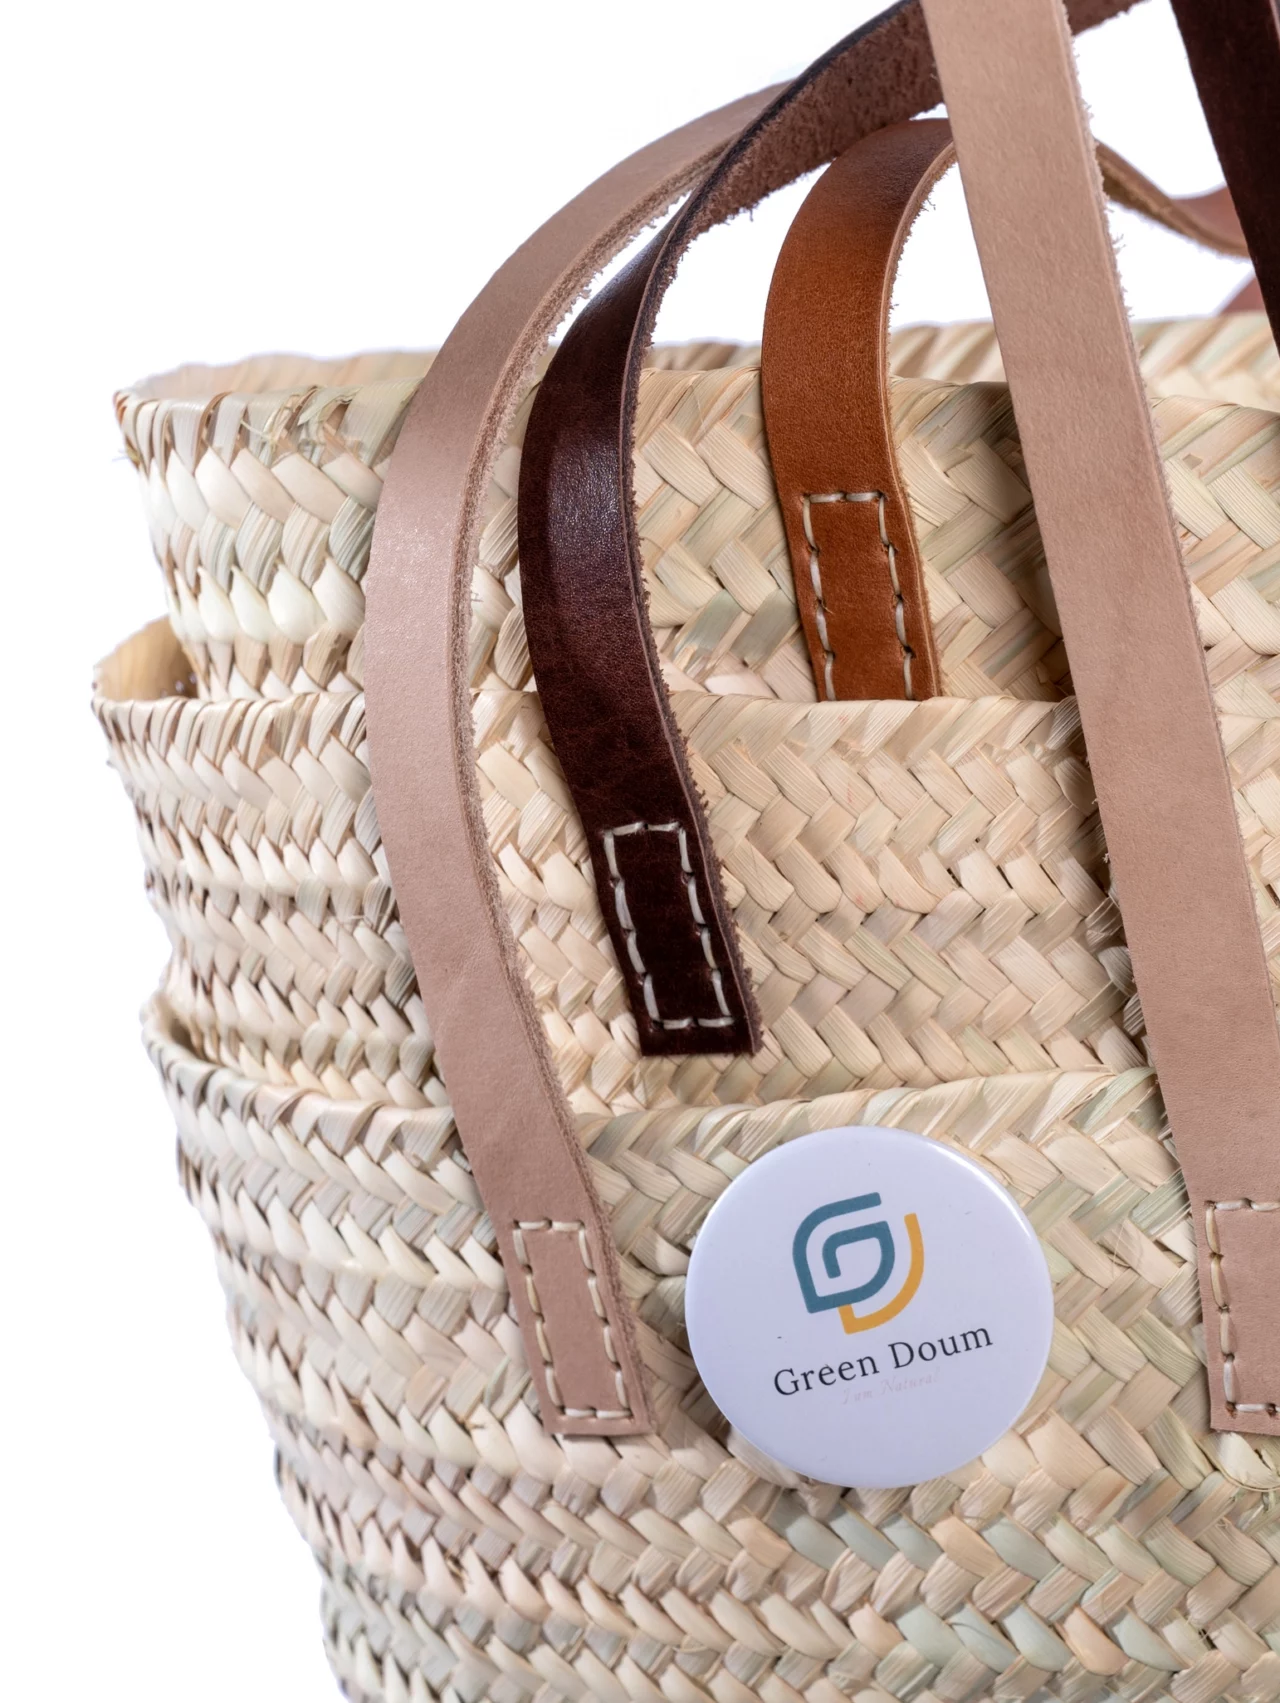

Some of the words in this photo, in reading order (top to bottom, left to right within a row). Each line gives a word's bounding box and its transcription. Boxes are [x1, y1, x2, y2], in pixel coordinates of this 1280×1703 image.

[773, 1356, 880, 1396] Green
[887, 1326, 994, 1370] Doum
[880, 1366, 941, 1395] Natural
